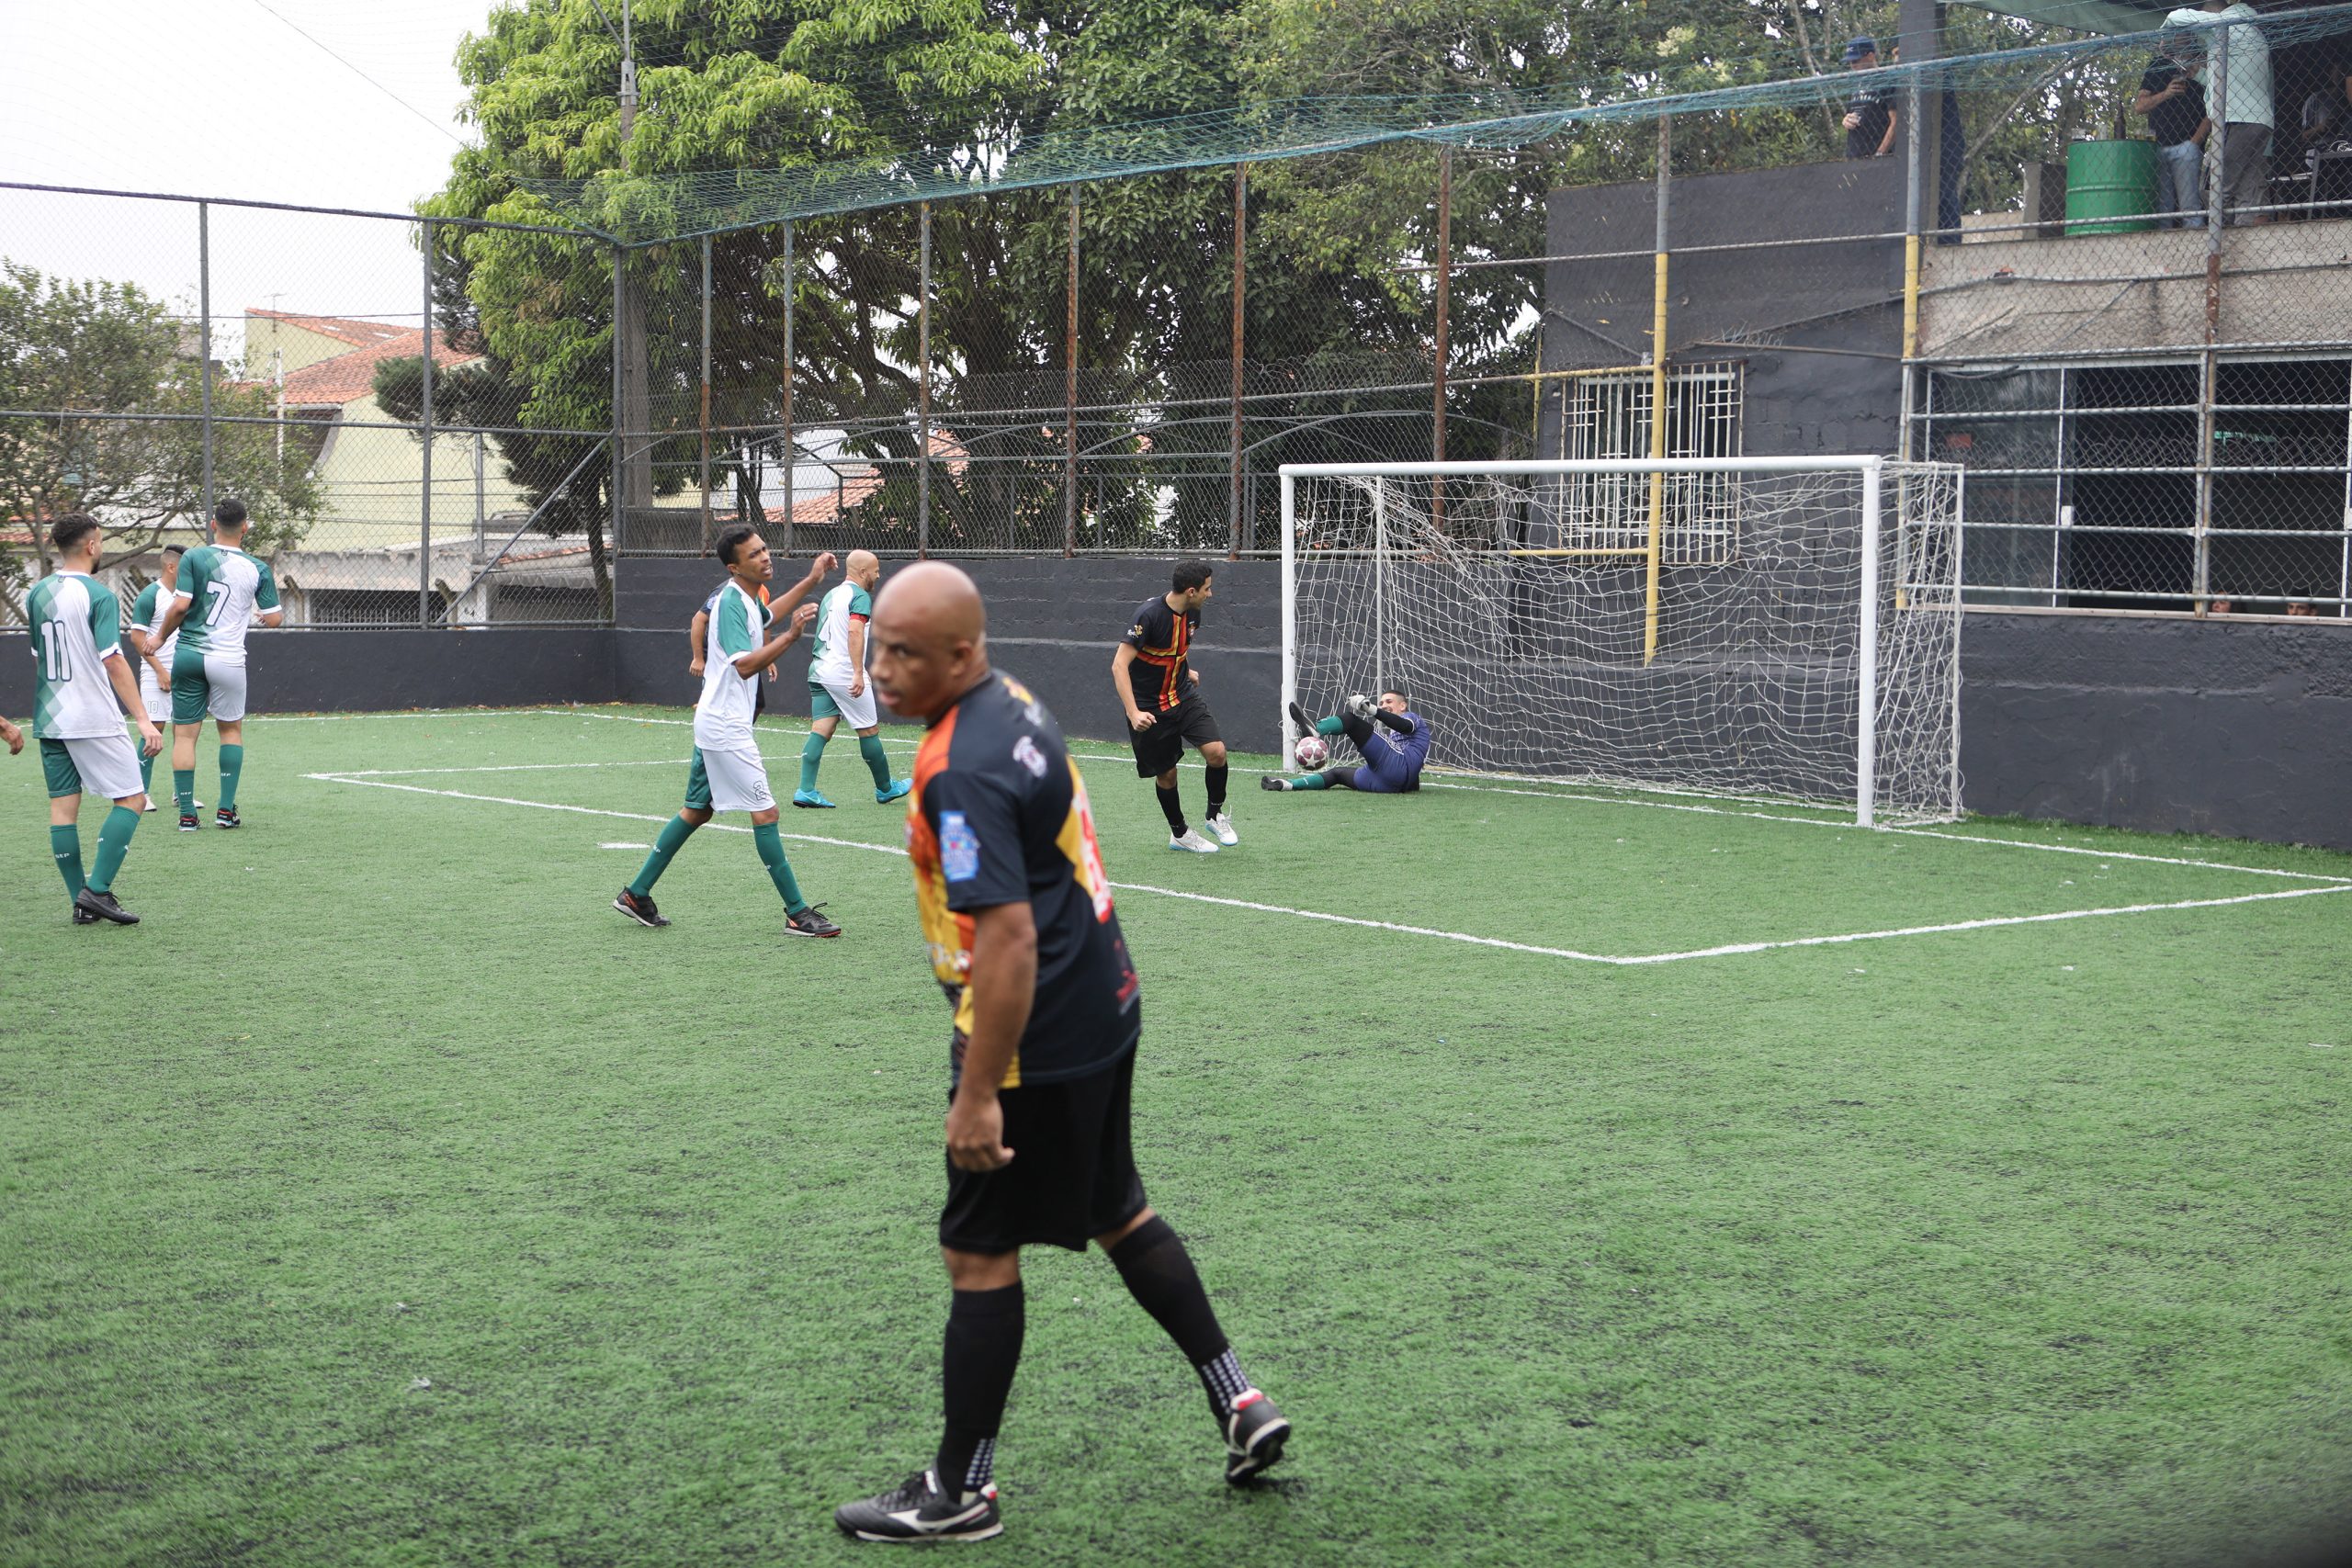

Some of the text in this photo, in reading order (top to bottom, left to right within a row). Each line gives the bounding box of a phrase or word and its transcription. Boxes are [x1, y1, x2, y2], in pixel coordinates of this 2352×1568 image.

[205, 580, 231, 626] 7
[818, 609, 832, 650] 4
[40, 619, 72, 682] 11
[147, 700, 158, 714] 10
[753, 780, 767, 801] 2
